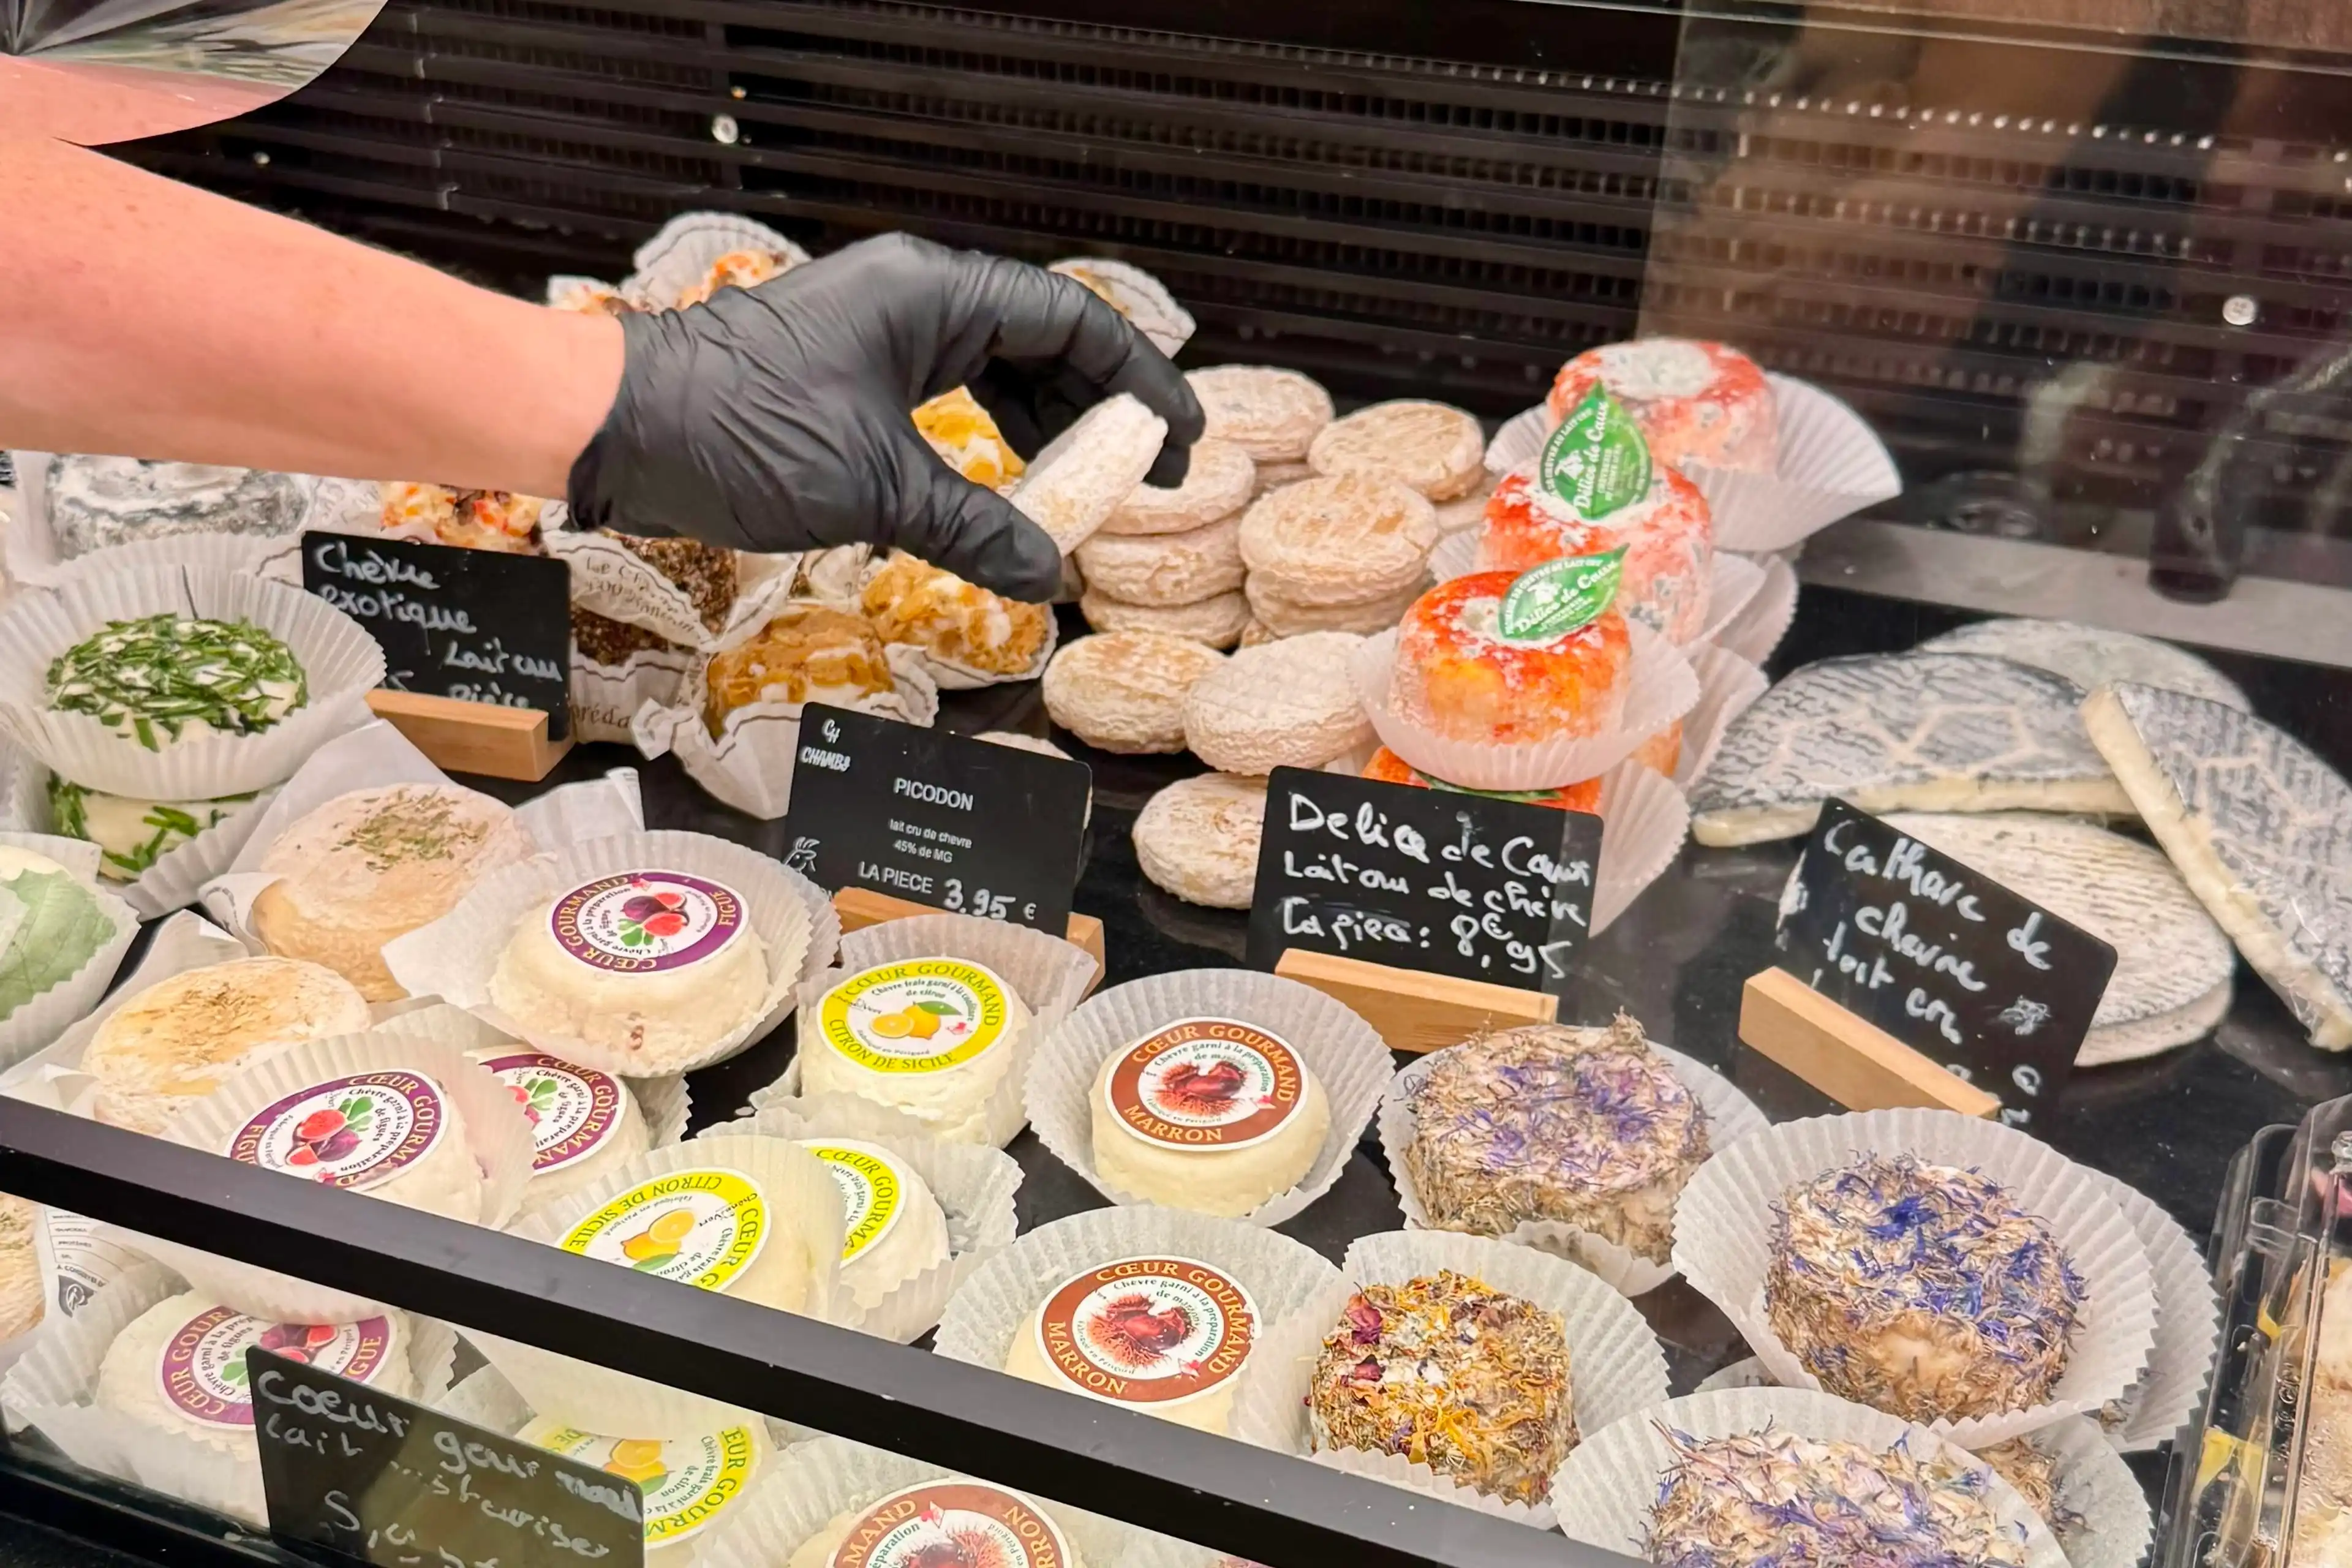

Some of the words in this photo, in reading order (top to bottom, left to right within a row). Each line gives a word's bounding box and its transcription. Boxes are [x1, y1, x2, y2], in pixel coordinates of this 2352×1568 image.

[893, 777, 974, 812] PICODON
[892, 839, 917, 855] 45%
[919, 845, 932, 859] de
[933, 848, 953, 864] MG
[707, 890, 736, 927] FIGUE
[858, 861, 880, 882] LA
[882, 867, 934, 894] PIECE
[1023, 903, 1037, 921] €
[1428, 871, 1474, 909] de
[557, 876, 630, 948] GOURMAND
[583, 948, 658, 970] CŒUR
[2007, 911, 2053, 970] de
[845, 967, 907, 997] CŒUR
[917, 963, 1001, 1027] GOURMAND
[829, 1018, 873, 1061] CITRON
[872, 1057, 899, 1069] DE
[902, 1051, 957, 1069] SICILE
[537, 1057, 602, 1085] CŒUR
[1132, 1025, 1200, 1063] CŒUR
[1208, 1024, 1297, 1102] GOURMAND
[348, 1074, 420, 1095] CŒUR
[1124, 1104, 1223, 1142] MARRON
[816, 1149, 881, 1175] CŒUR
[619, 1195, 647, 1212] DE
[652, 1175, 723, 1196] CITRON
[569, 1210, 619, 1248] SICILE
[720, 1207, 760, 1267] CŒUR
[1156, 1289, 1171, 1298] de
[172, 1311, 238, 1363] GOUR
[1095, 1262, 1179, 1281] CŒUR
[1188, 1268, 1250, 1374] GOURMAND
[217, 1351, 230, 1361] de
[1048, 1321, 1128, 1395] MARRON
[170, 1366, 228, 1415] CŒUR
[684, 1464, 699, 1476] de
